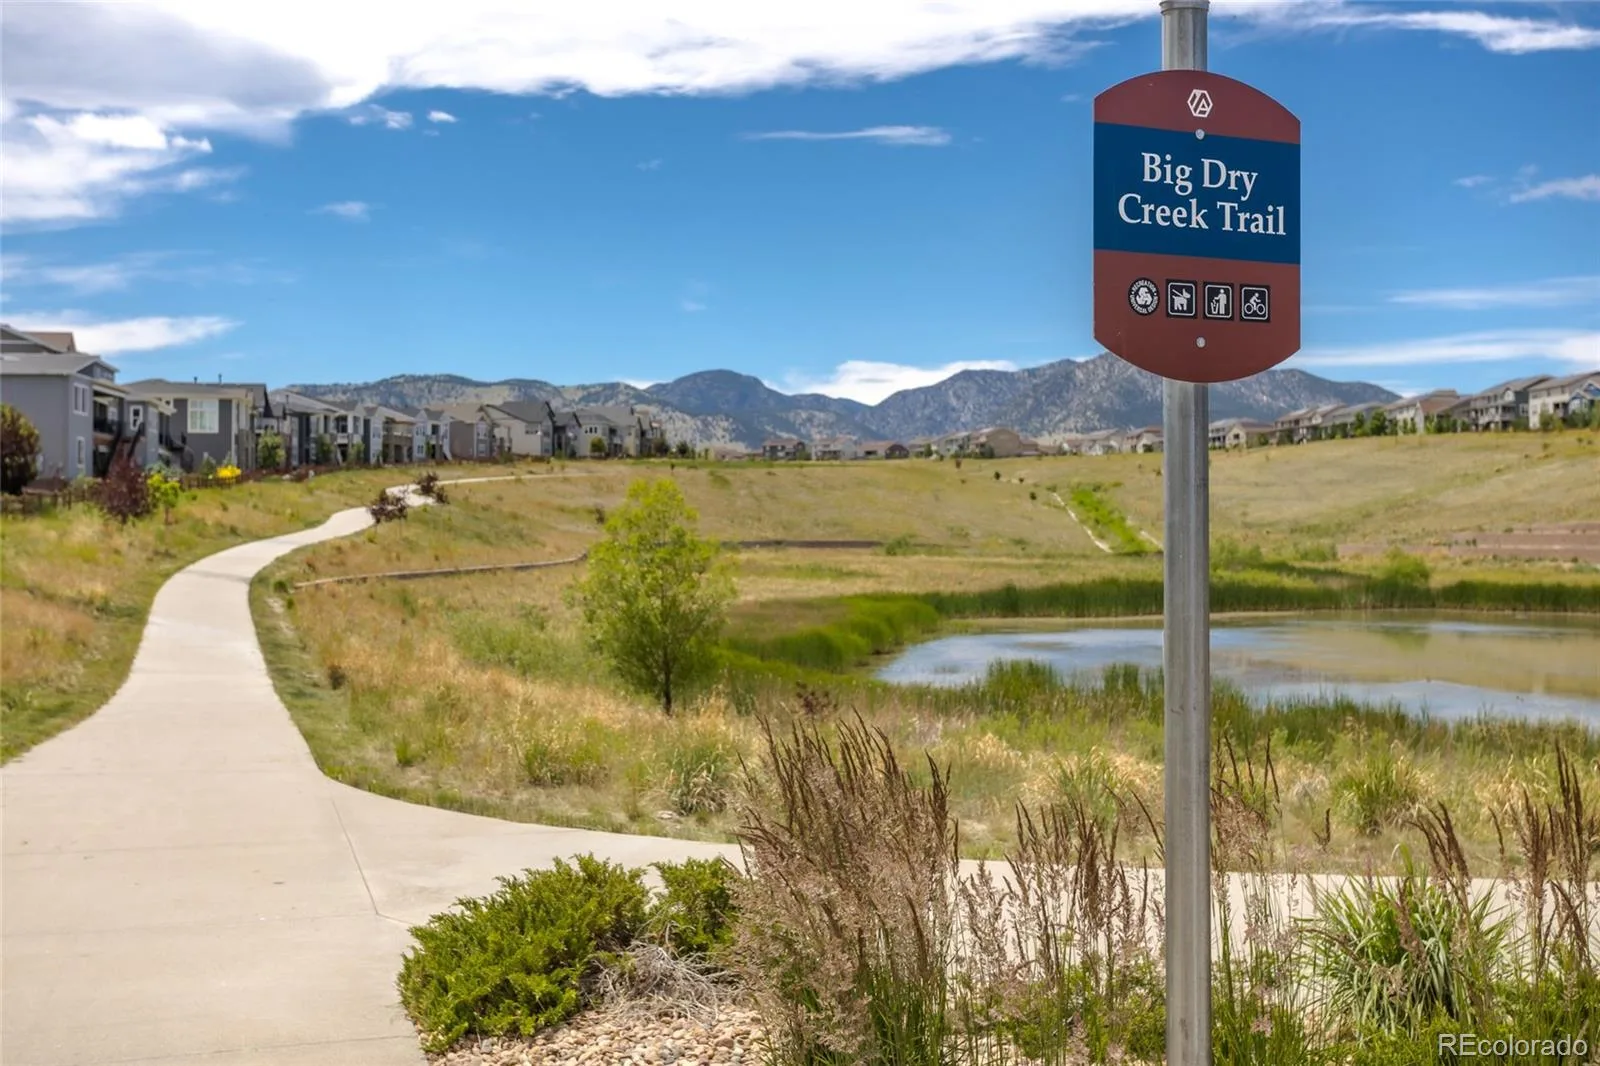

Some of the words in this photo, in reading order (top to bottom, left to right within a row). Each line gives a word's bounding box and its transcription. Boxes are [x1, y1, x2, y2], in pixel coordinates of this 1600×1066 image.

[1141, 152, 1192, 196] Big
[1200, 158, 1258, 201] Dry
[1118, 193, 1209, 229] Creek
[1216, 201, 1286, 236] Trail
